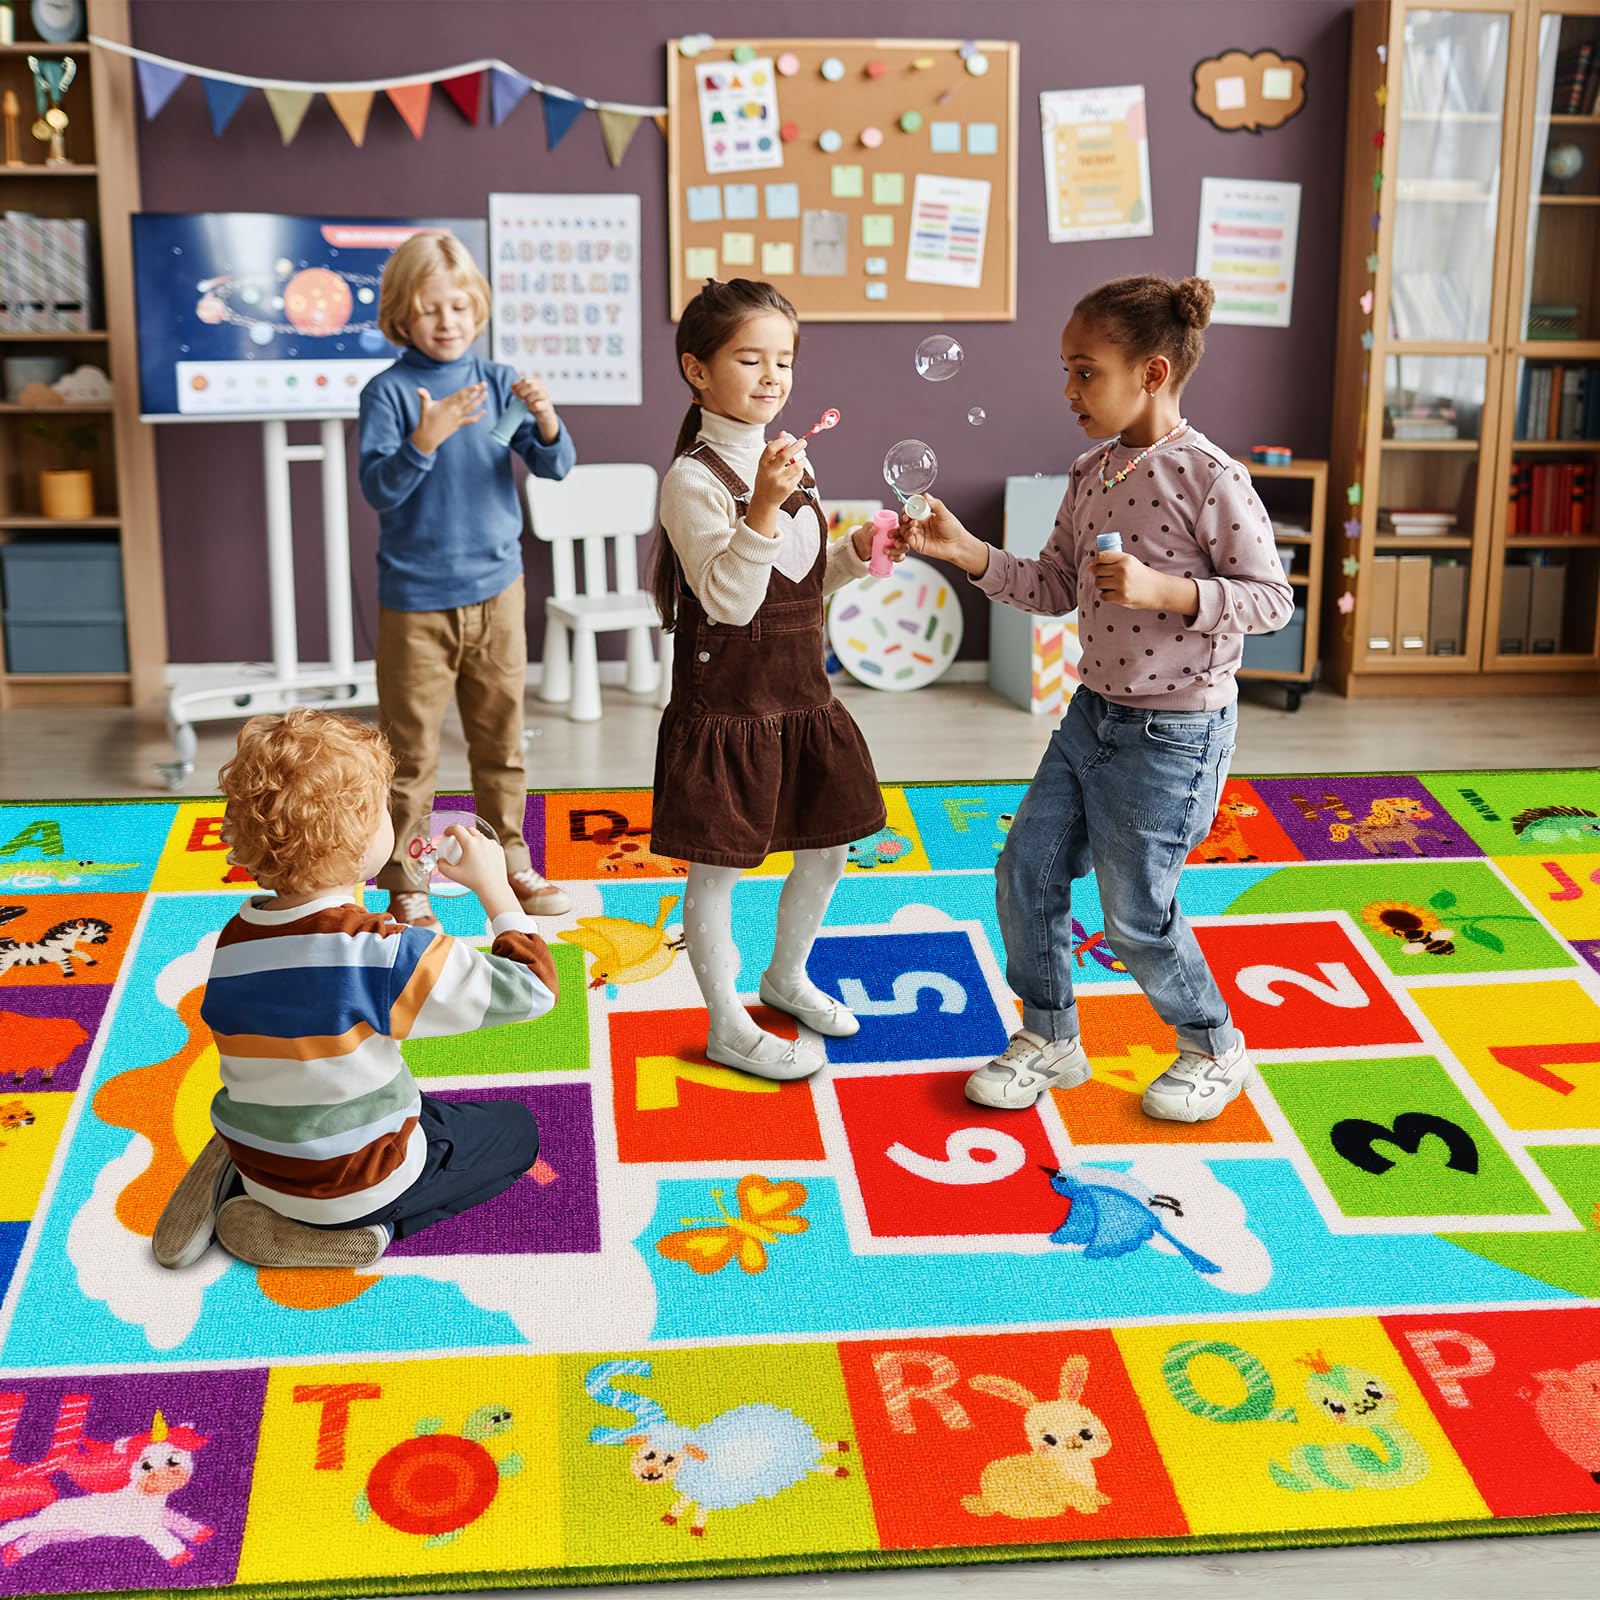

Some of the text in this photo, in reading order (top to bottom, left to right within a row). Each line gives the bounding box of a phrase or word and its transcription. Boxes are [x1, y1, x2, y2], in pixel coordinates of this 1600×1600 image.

[569, 809, 629, 842] D
[943, 798, 988, 832] F
[1290, 792, 1356, 821] H
[0, 820, 65, 856] A
[838, 971, 968, 1015] 5
[1235, 961, 1371, 1008] 2
[1330, 1111, 1480, 1175] 3
[871, 1350, 974, 1434] R
[1162, 1339, 1299, 1424] Q
[1404, 1329, 1497, 1409] P
[293, 1383, 382, 1471] T
[584, 1360, 669, 1446] S
